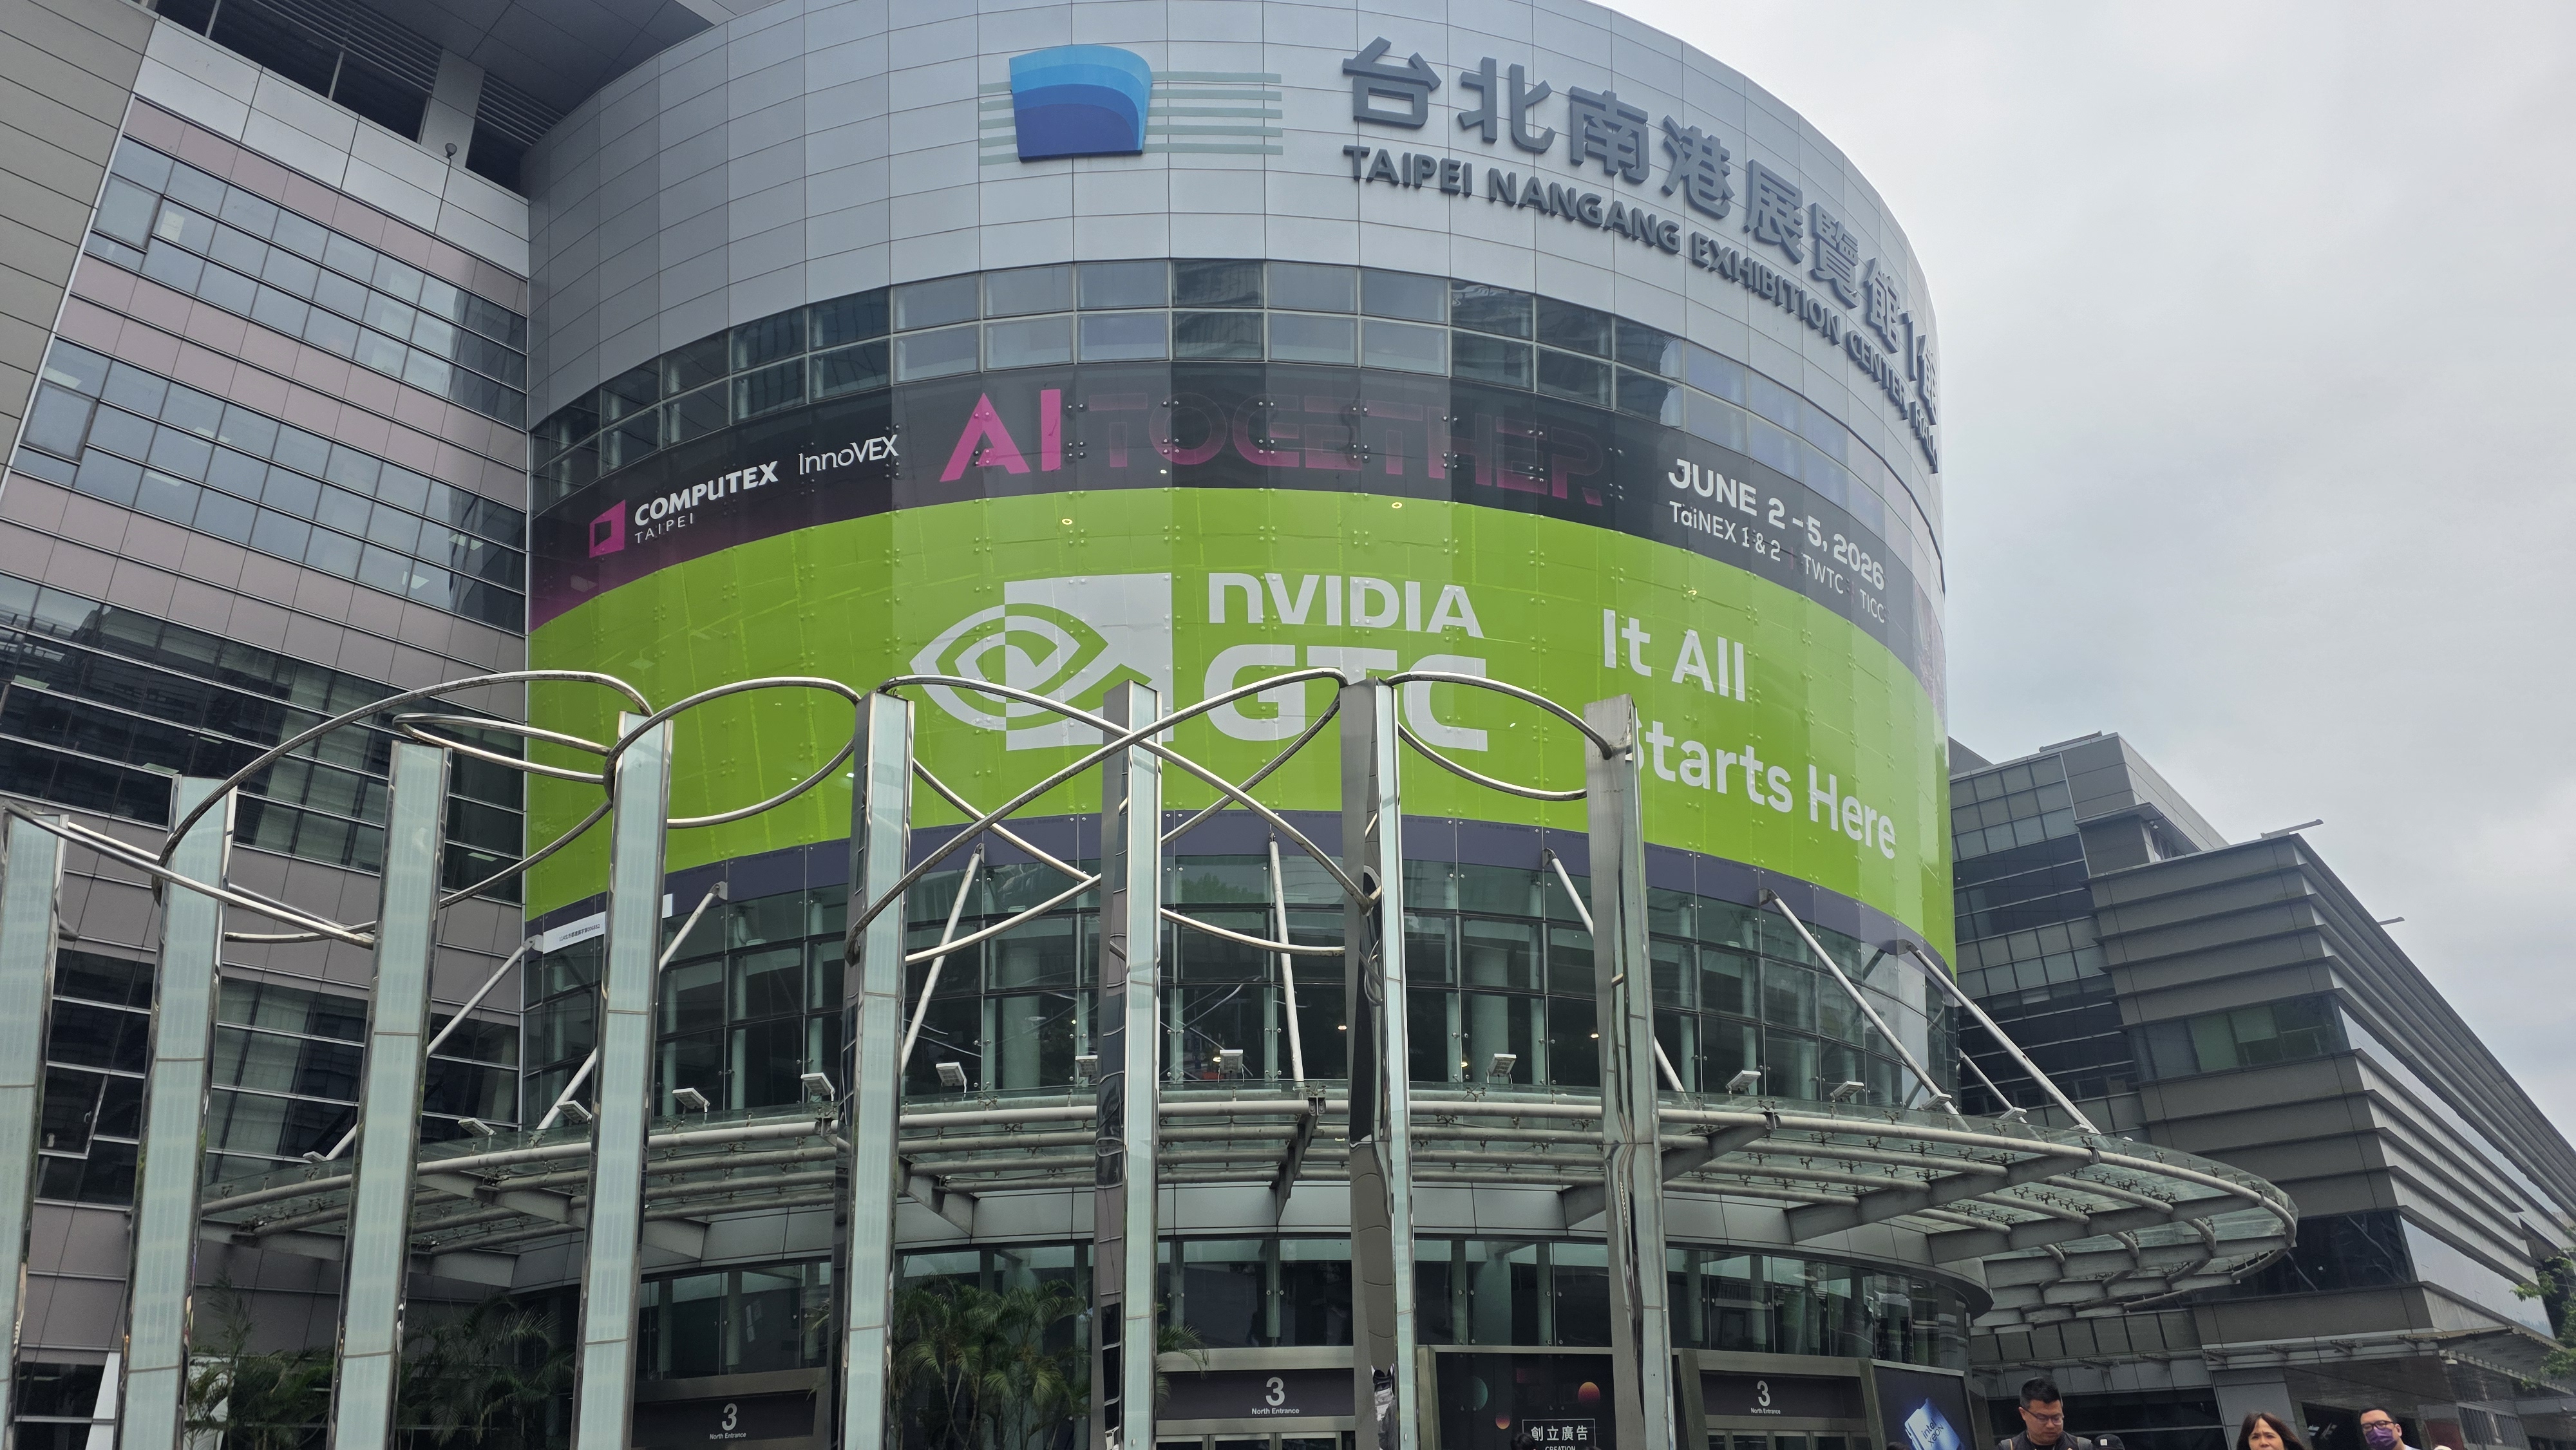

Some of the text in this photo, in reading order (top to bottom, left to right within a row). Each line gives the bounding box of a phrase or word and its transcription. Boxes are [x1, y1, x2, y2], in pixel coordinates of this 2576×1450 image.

[1343, 144, 1472, 197] TAIPEI
[1488, 167, 1681, 255] NANGANG
[1691, 231, 1841, 346] EXHIBITION
[634, 435, 900, 527] COMPUTEX InnoVEX
[940, 389, 1061, 482] AI
[635, 513, 694, 544] TAIPEI
[1668, 458, 1757, 517] JUNE
[1833, 533, 1884, 591] 2026
[1669, 500, 1885, 624] TaiNEX 1 & 2 TWTC TICC
[1604, 608, 1746, 702] It All
[1809, 764, 1896, 860] Here
[721, 1403, 737, 1431] 3
[1265, 1377, 1285, 1406] 3
[1531, 1425, 1588, 1442] 創立廣告
[1757, 1380, 1770, 1407] 3
[1921, 1418, 1937, 1439] intel
